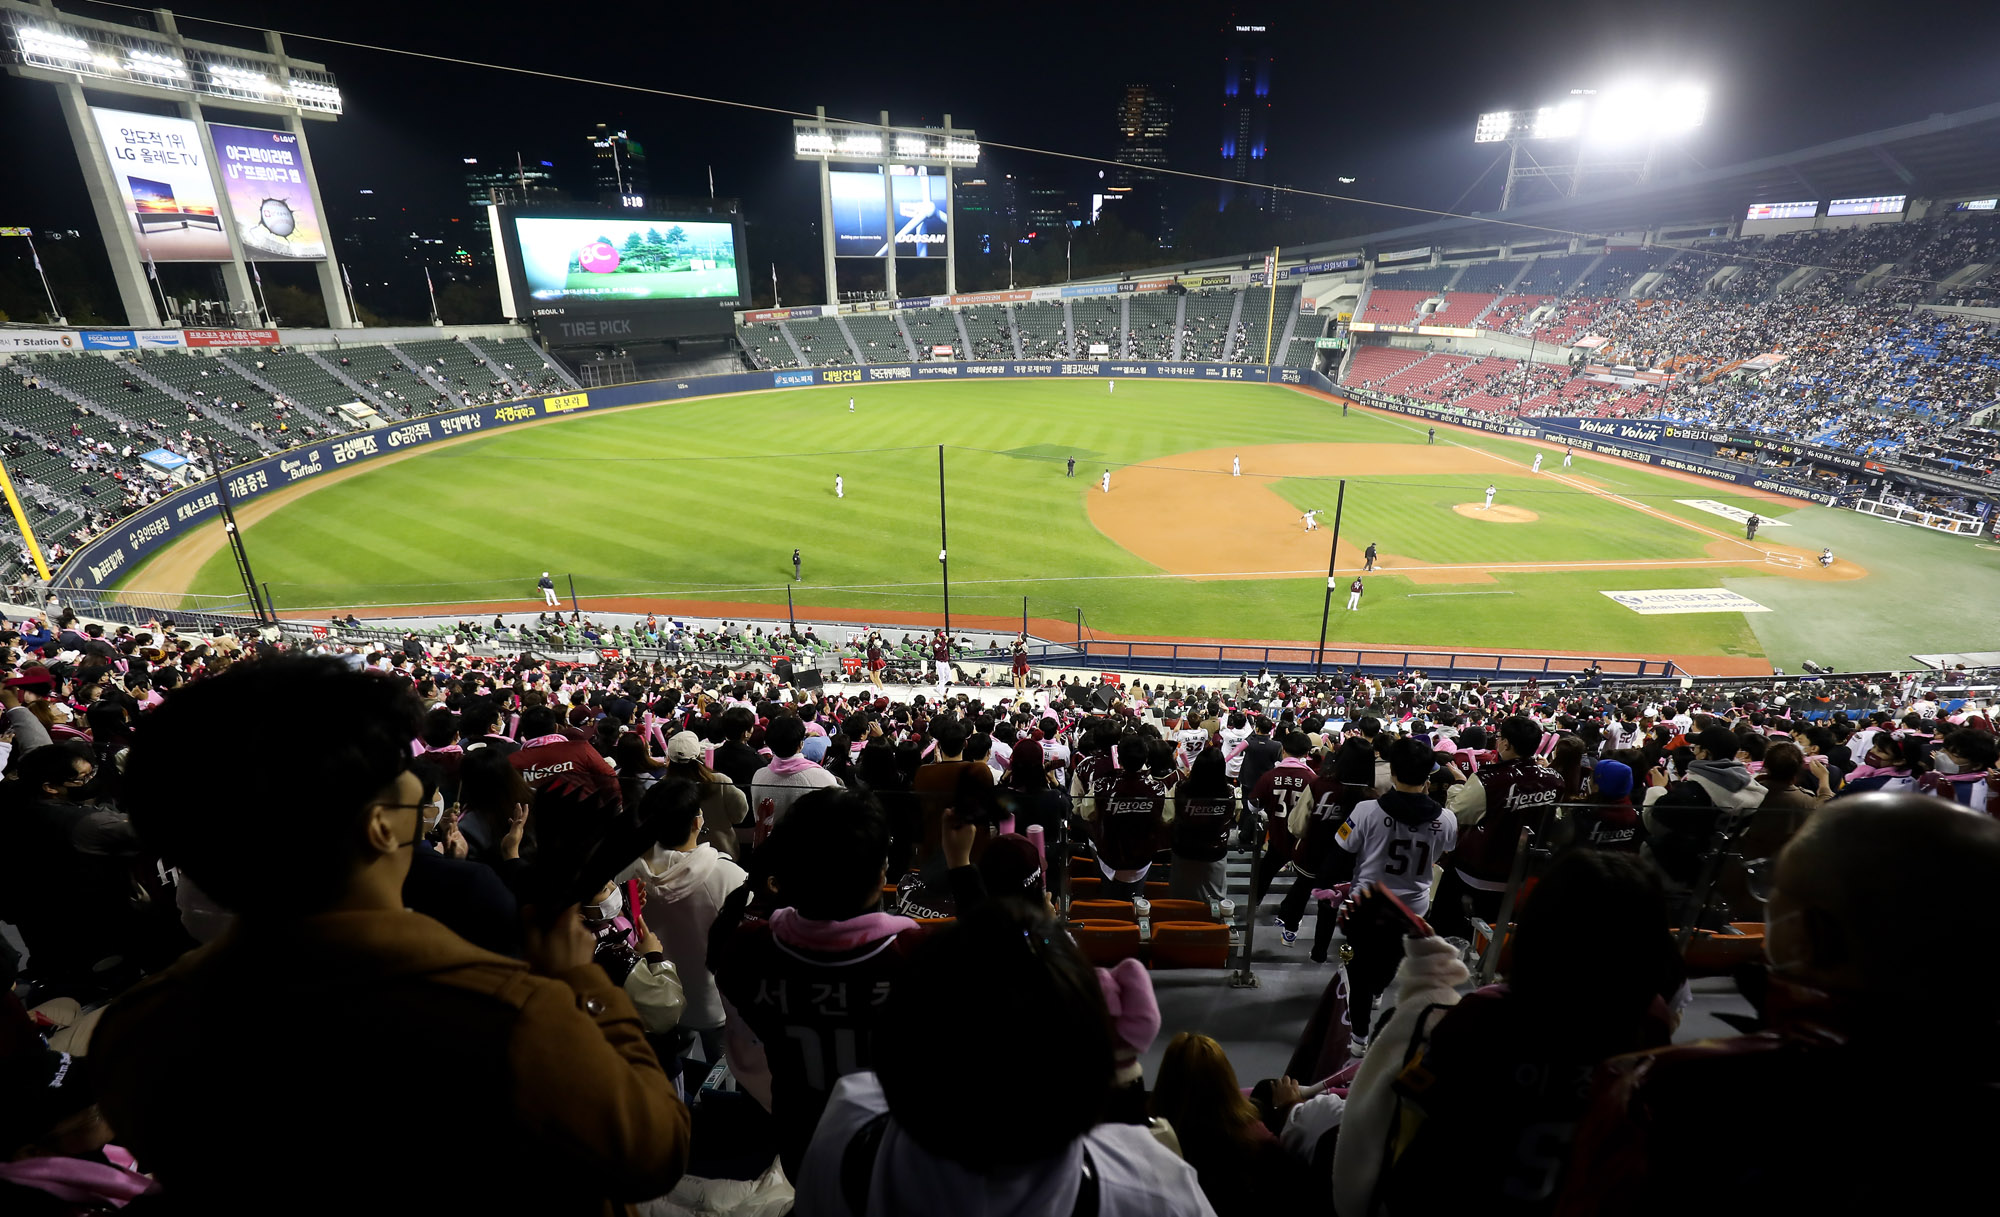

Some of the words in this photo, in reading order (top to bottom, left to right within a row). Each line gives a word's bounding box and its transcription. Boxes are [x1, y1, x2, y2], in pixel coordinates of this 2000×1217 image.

[121, 127, 164, 147] 압도적
[166, 134, 186, 149] 1위
[115, 146, 136, 160] LG
[140, 148, 180, 164] 올레드
[180, 153, 198, 166] TV
[225, 145, 294, 166] 야구팬이라면
[897, 233, 946, 244] DOOSAN
[580, 243, 611, 264] BC
[560, 321, 597, 337] TIRE
[600, 320, 632, 334] PICK
[782, 375, 813, 384] 도미노피자
[823, 369, 862, 382] 대방건설
[554, 396, 580, 409] 유보라
[494, 406, 536, 422] 서경대학교
[440, 412, 481, 435] 현대해상
[1579, 419, 1616, 435] Volvik
[402, 422, 432, 442] 금강주택
[1545, 433, 1567, 445] meritz
[1621, 426, 1659, 442] Volvik
[1674, 428, 1709, 441] 농협김치
[332, 435, 379, 464] 금성백조
[1597, 445, 1621, 457] meritz
[290, 462, 322, 480] Buffalo
[228, 469, 268, 498] 키움증권
[1923, 709, 1934, 718] 20
[1619, 732, 1633, 744] 52
[1186, 741, 1202, 752] 52
[522, 760, 574, 783] Nexen
[1273, 776, 1304, 788] 김초딩
[1385, 839, 1431, 876] 51
